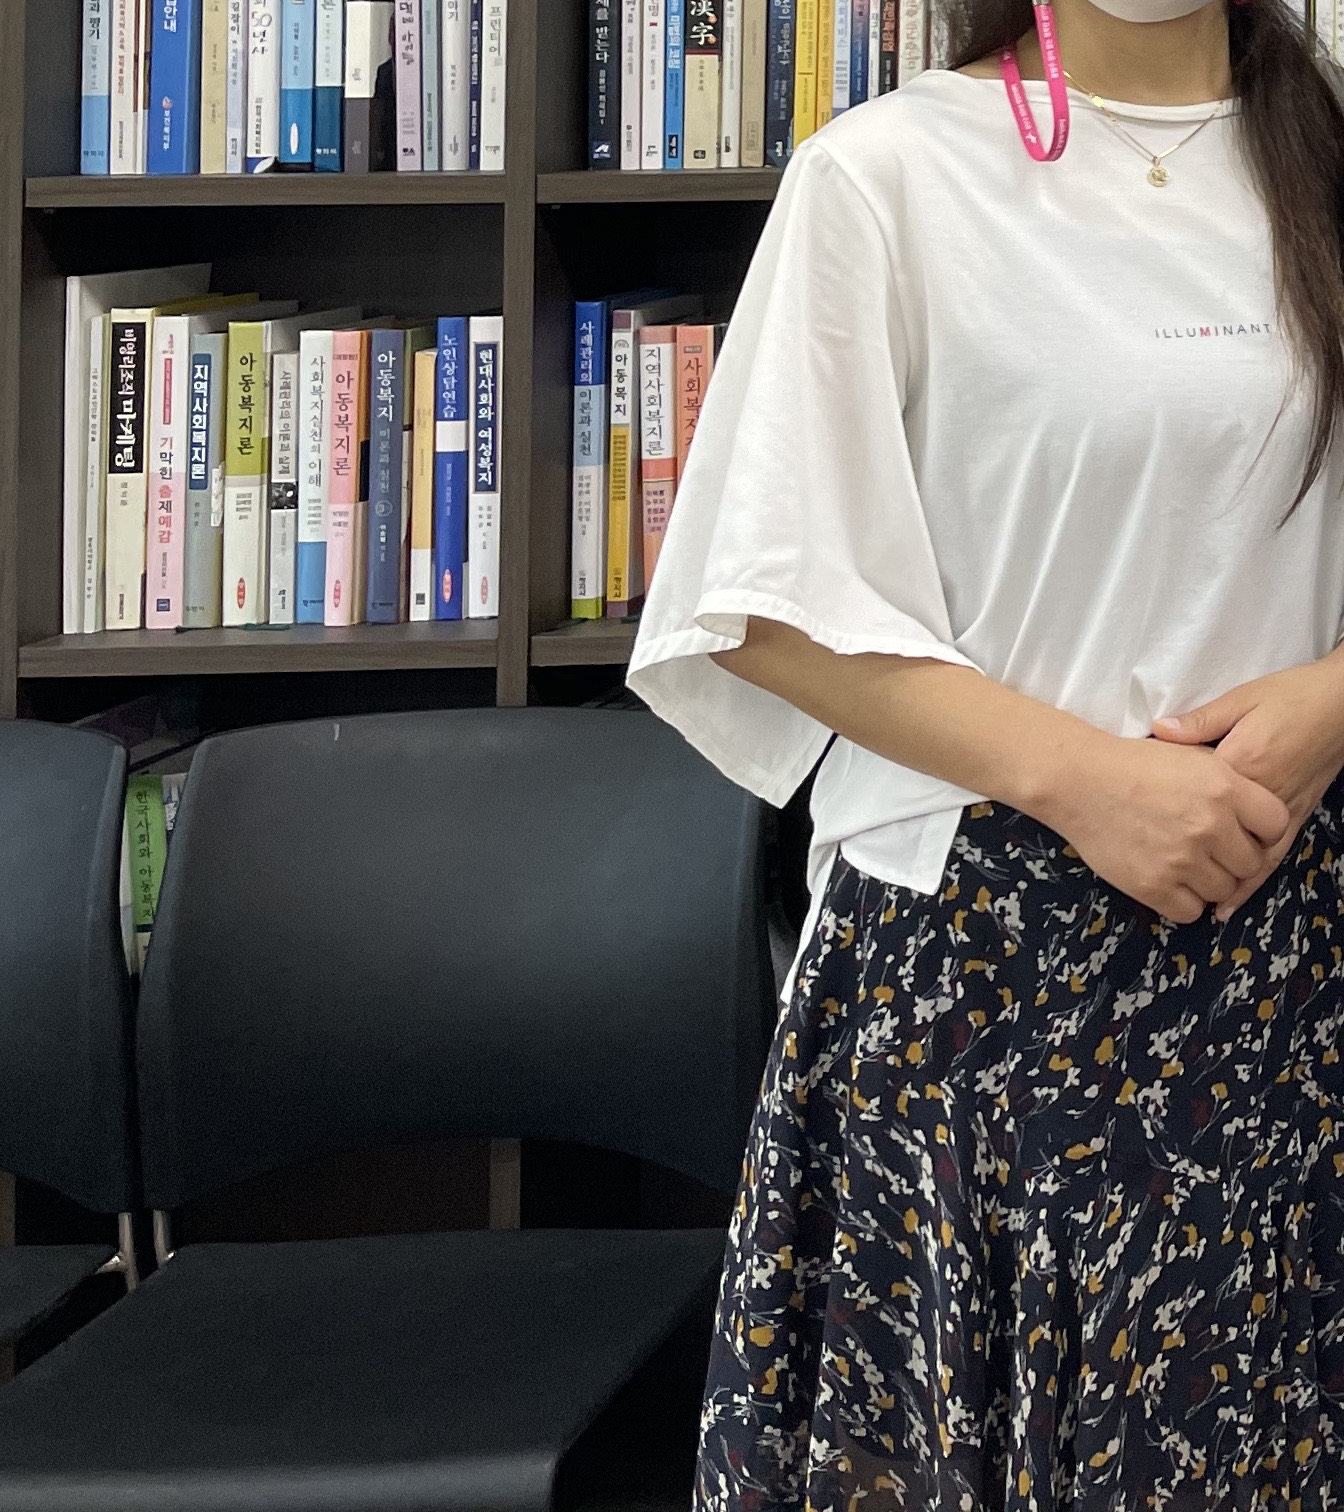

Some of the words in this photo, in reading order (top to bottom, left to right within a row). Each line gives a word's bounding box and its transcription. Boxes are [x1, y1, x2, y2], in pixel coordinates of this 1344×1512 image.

[119, 328, 136, 395] 비영리조직
[1155, 323, 1271, 339] ILLUMINANT
[238, 352, 256, 455] 아동복지론
[376, 350, 396, 422] 아동복지
[478, 349, 495, 422] 현대사회와
[614, 353, 628, 416] 아동복지
[115, 397, 137, 469] 마케팅
[333, 370, 355, 476] 아동복지론
[477, 427, 493, 486] 여성복지
